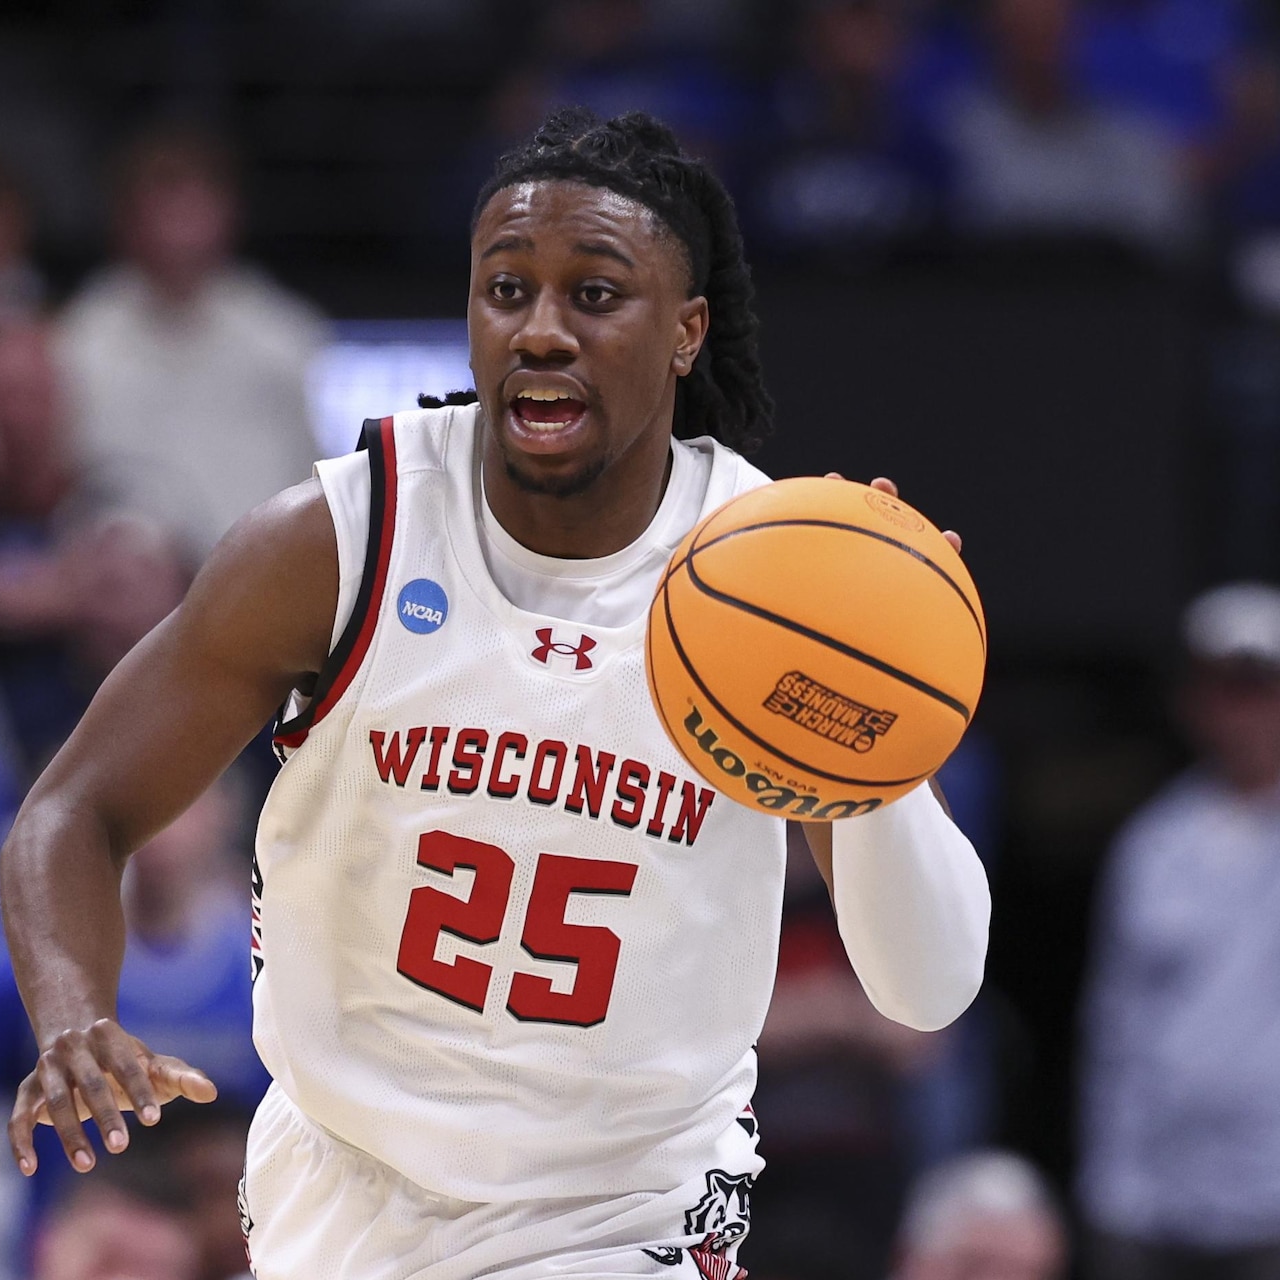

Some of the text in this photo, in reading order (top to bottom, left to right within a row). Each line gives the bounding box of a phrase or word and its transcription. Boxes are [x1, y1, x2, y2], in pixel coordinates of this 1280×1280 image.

[402, 600, 443, 625] NCAA
[778, 675, 862, 726] MADNESS
[795, 707, 860, 745] MARCH
[369, 726, 715, 848] WISCONSIN
[754, 760, 817, 794] EVO NXT
[397, 830, 639, 1028] 25
